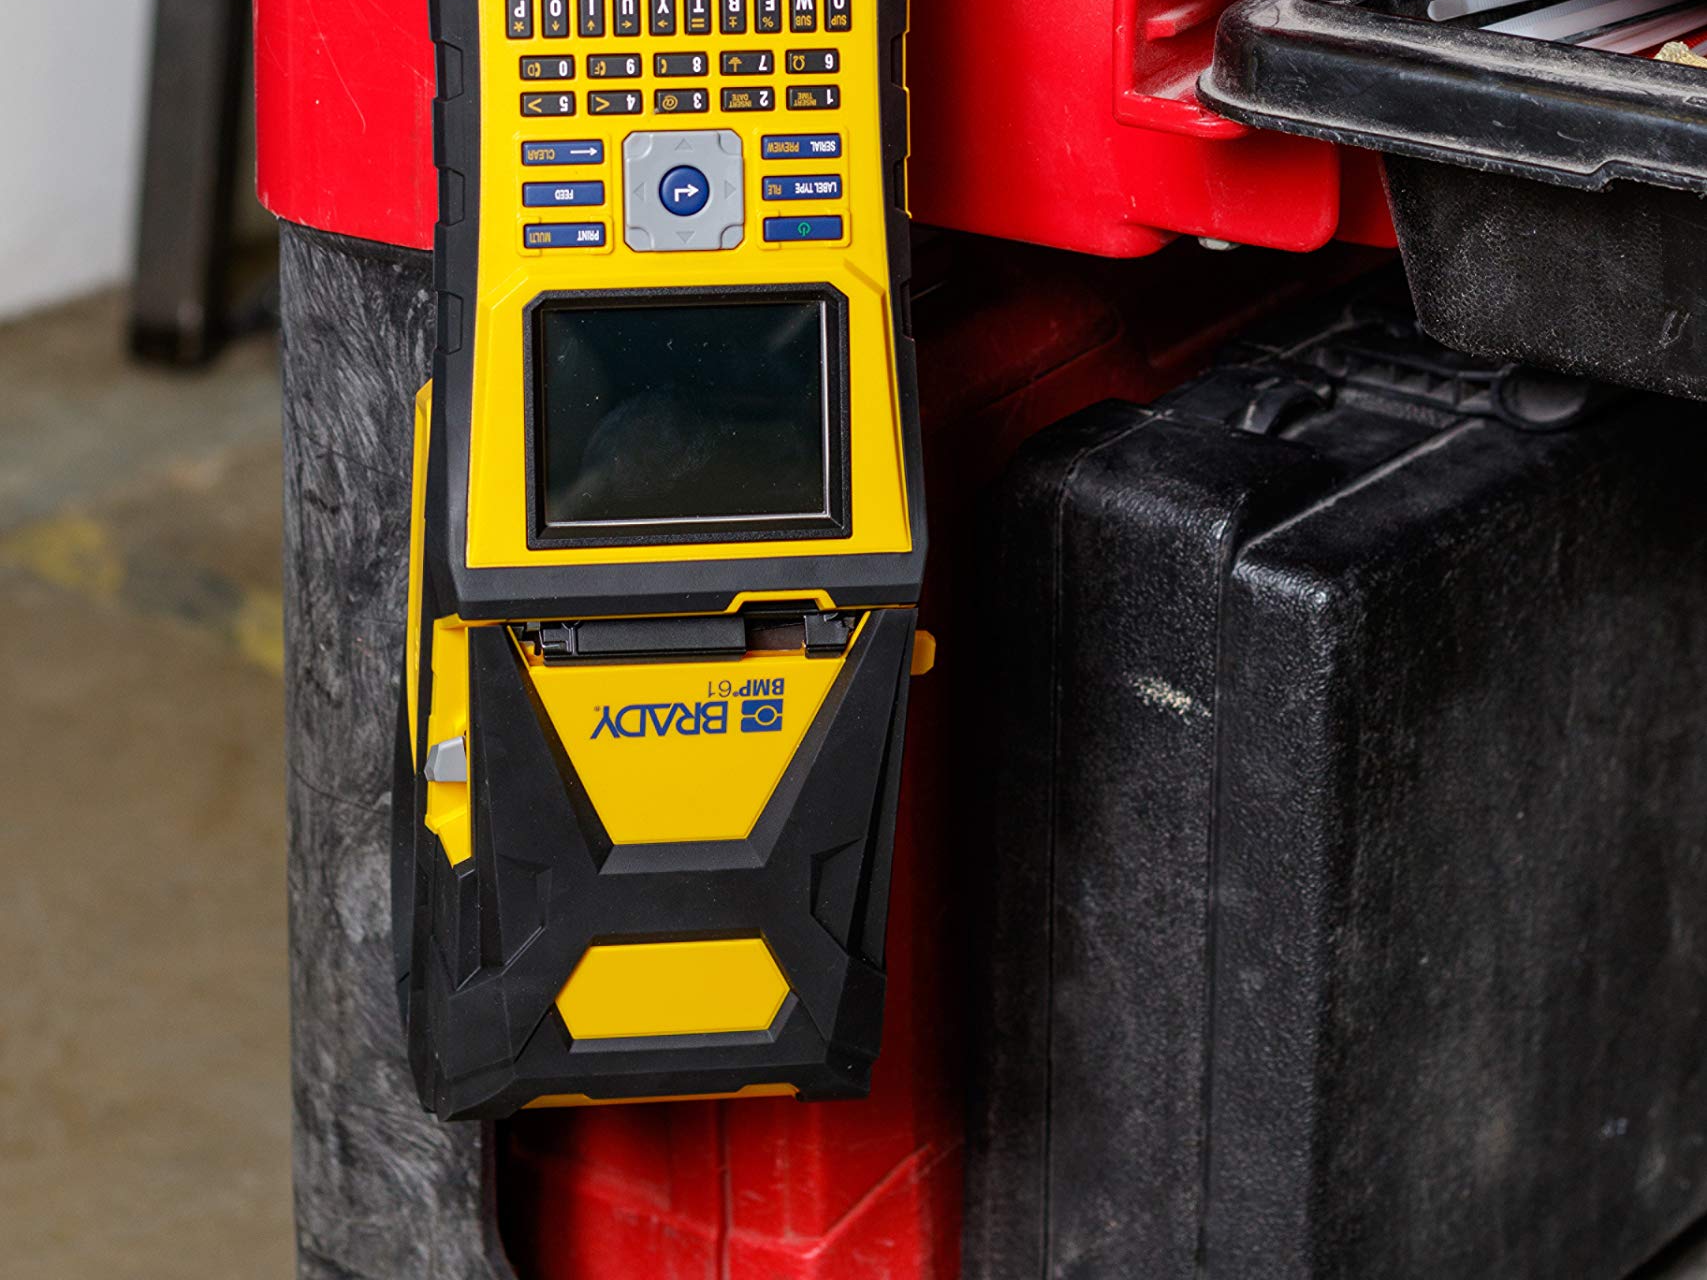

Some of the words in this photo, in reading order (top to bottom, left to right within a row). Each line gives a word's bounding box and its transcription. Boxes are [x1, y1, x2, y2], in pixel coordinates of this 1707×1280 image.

[513, 0, 525, 17] P
[549, 0, 561, 16] O
[795, 15, 811, 26] SUB
[831, 14, 846, 26] SUP
[626, 58, 635, 74] 9
[692, 56, 701, 72] 8
[758, 54, 767, 70] 7
[824, 53, 833, 69] 6
[626, 94, 636, 111] 4
[693, 92, 702, 109] 3
[759, 90, 768, 106] 2
[826, 89, 834, 104] 1
[559, 96, 568, 111] 5
[767, 141, 799, 152] PREVIEW
[810, 140, 836, 151] SERIAL
[527, 149, 554, 160] CLEAR
[768, 184, 781, 195] FILE
[795, 182, 813, 193] TYPE
[814, 182, 836, 192] LABEL
[554, 189, 573, 199] FEED
[529, 232, 551, 243] MULTI
[577, 230, 599, 241] PRINT
